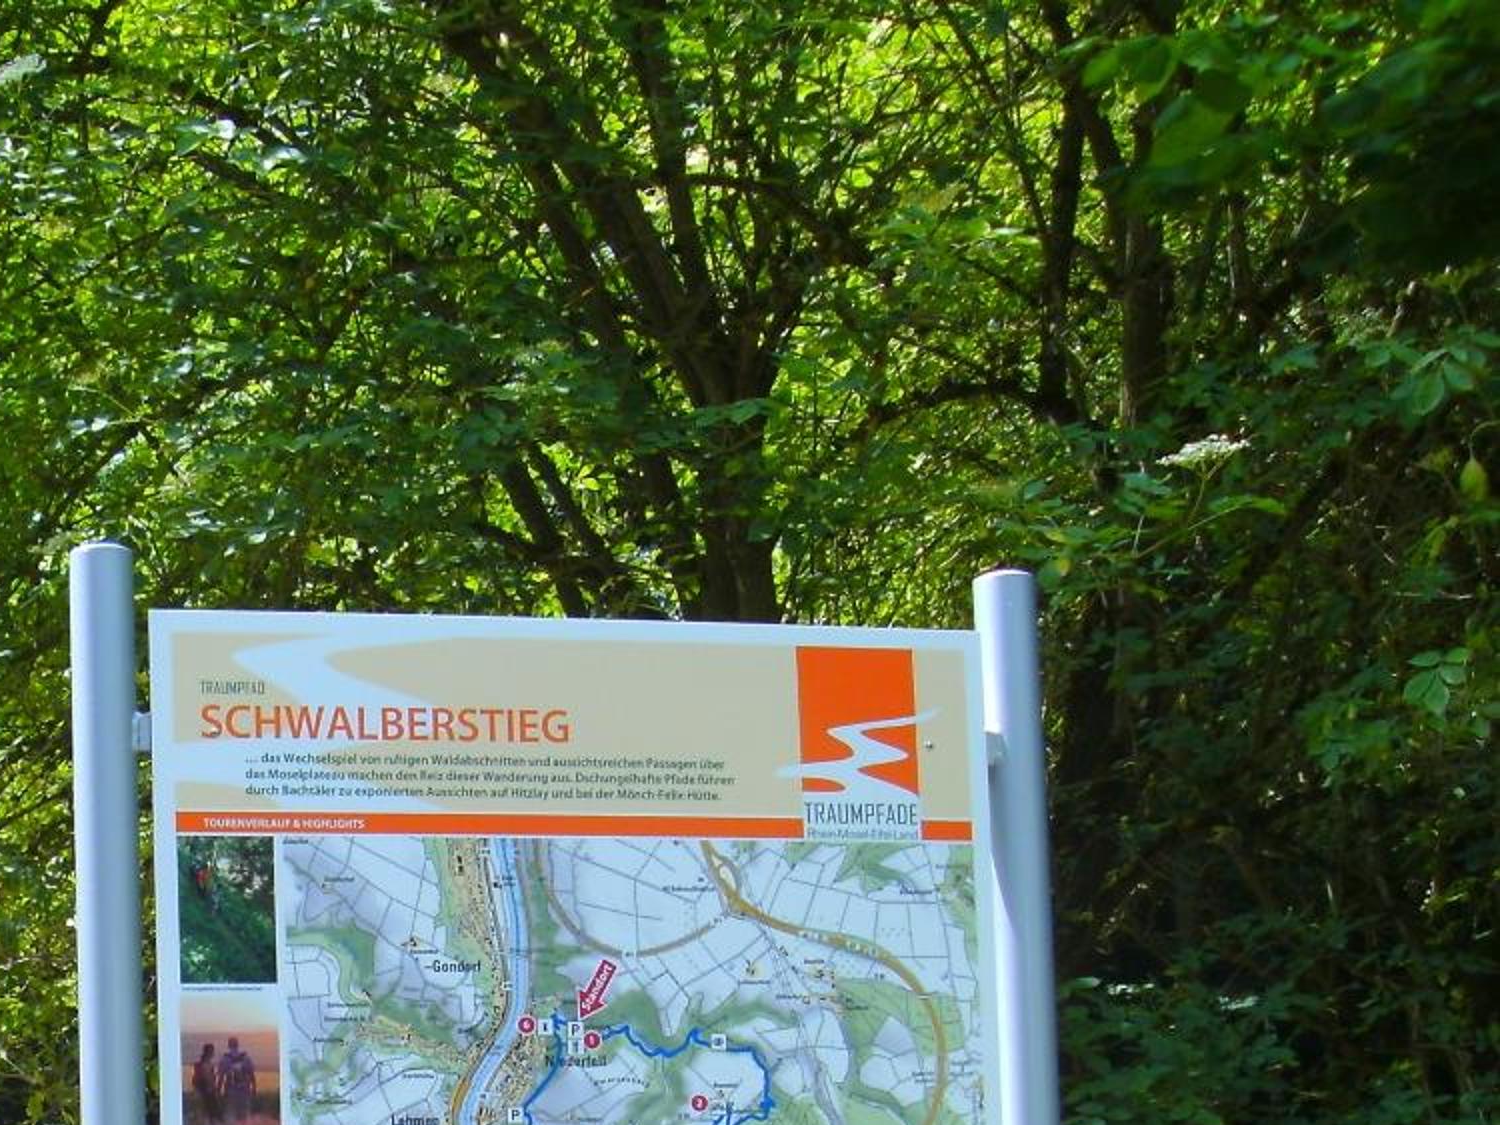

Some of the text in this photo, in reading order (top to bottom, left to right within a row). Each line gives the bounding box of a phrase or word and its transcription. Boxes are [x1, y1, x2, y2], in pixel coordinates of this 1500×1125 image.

[200, 680, 265, 695] TRAUMPFAD
[201, 703, 570, 743] SCHWALBERSTIEG
[261, 753, 280, 764] das
[283, 753, 356, 768] Wechselspiel
[360, 756, 380, 766] von
[384, 754, 428, 768] ruhigen
[431, 754, 526, 768] Waldabschnitten
[528, 756, 550, 768] und
[553, 756, 642, 770] aussichtsreichen
[646, 758, 696, 772] Passagen
[700, 758, 724, 771] über
[245, 769, 265, 780] das
[268, 769, 344, 783] Moselplateau
[348, 770, 393, 781] machen
[396, 770, 418, 781] den
[446, 771, 479, 782] dieser
[483, 771, 548, 785] Wanderung
[576, 772, 662, 786] Dschungelhafte
[665, 774, 695, 785] Pfade
[698, 774, 735, 786] führen
[245, 786, 279, 796] durch
[282, 786, 335, 797] Bachtäler
[339, 788, 351, 797] zu
[354, 787, 423, 800] exponierten
[426, 787, 488, 799] Aussichten
[490, 788, 508, 799] auf
[552, 788, 572, 799] und
[575, 788, 594, 800] bei
[598, 789, 615, 800] der
[803, 801, 917, 825] TRAUMPFADE
[303, 818, 366, 830] HIGHLIGHTS
[581, 963, 614, 1012] Standort
[571, 1024, 581, 1036] P
[511, 1109, 521, 1121] P
